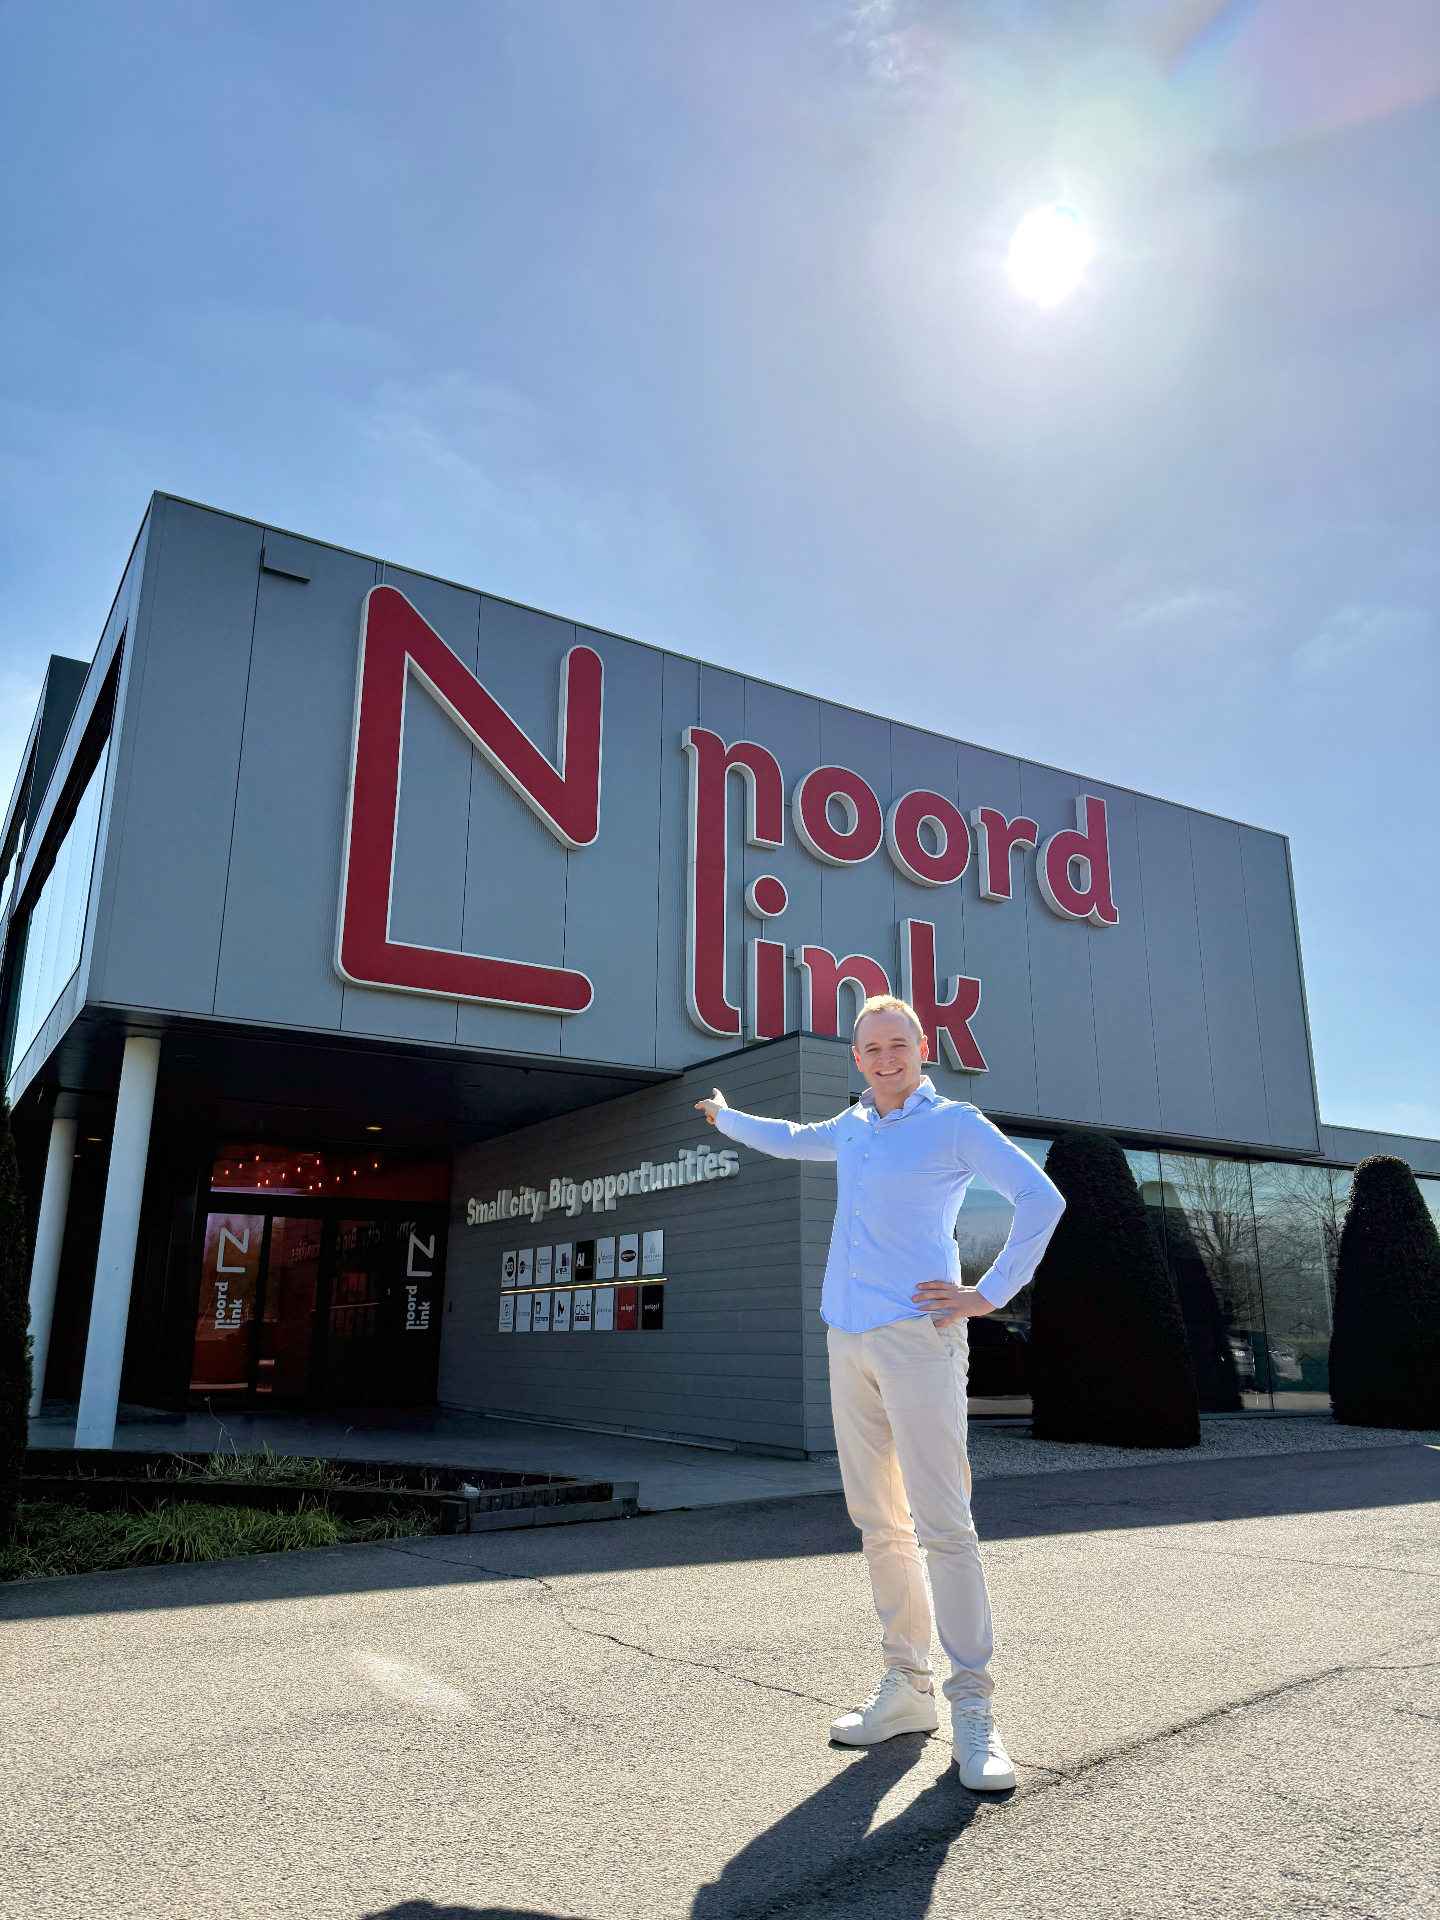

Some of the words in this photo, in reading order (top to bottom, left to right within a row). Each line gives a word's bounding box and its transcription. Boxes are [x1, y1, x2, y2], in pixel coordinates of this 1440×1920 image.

[682, 726, 1119, 928] noord
[467, 1189, 512, 1226] Small
[509, 1185, 549, 1223] city.
[550, 1177, 582, 1217] Big
[581, 1144, 739, 1213] opportunities
[214, 1281, 228, 1330] noord
[226, 1299, 242, 1329] link
[406, 1285, 418, 1330] noord
[416, 1301, 430, 1330] link
